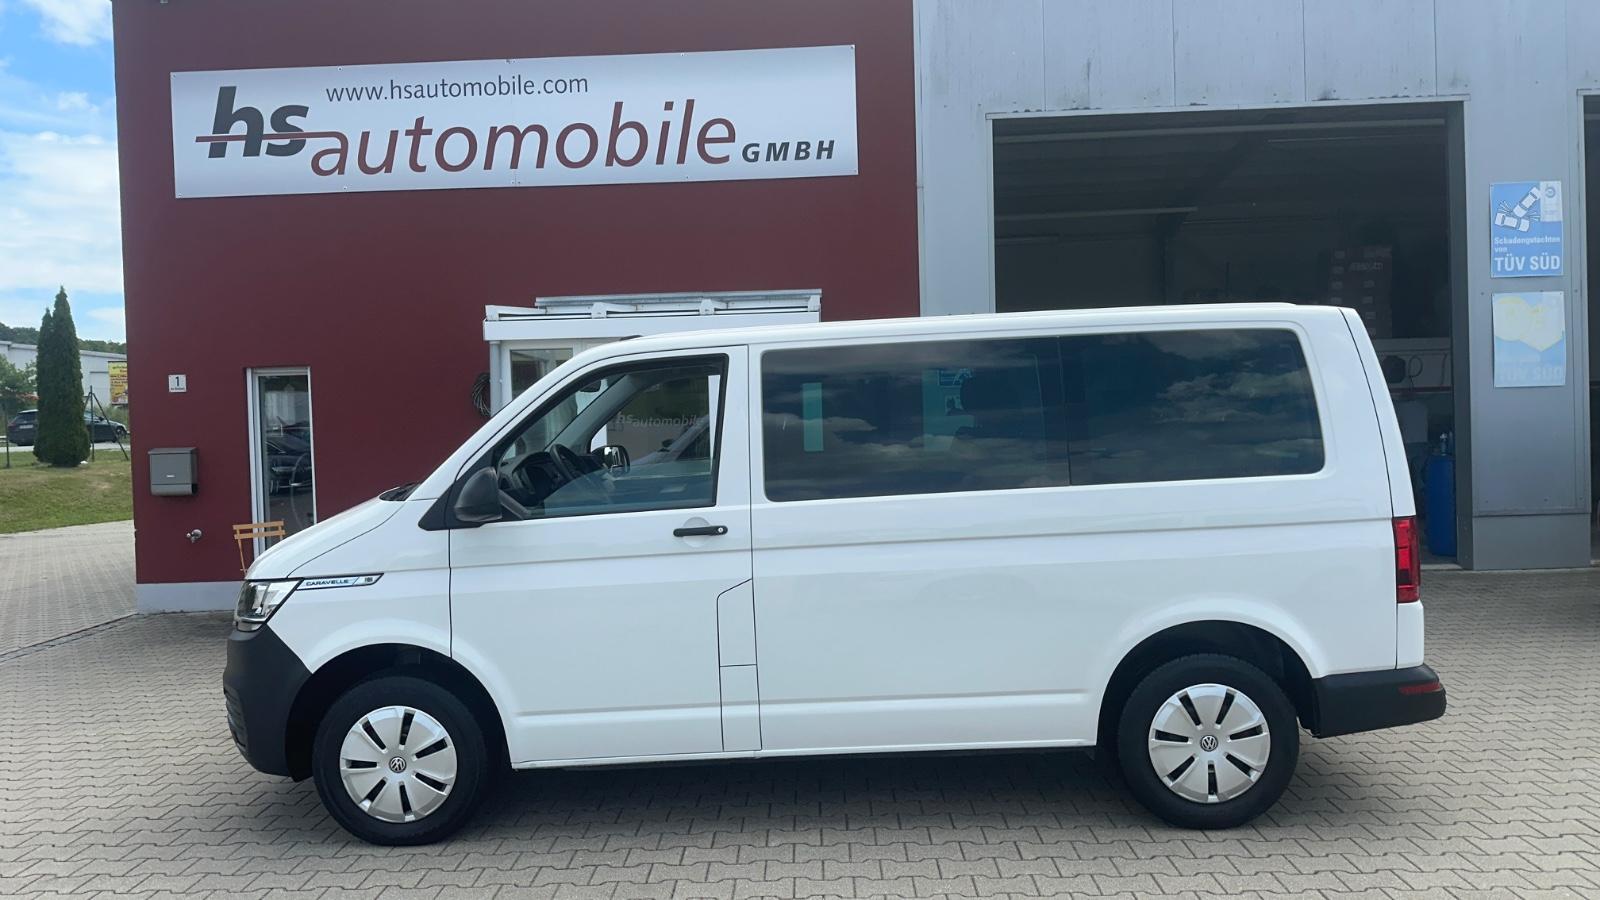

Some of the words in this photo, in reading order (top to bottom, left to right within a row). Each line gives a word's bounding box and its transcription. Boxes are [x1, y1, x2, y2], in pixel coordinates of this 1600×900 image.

[326, 74, 589, 102] www.hsautomobile.com
[207, 85, 310, 159] hs
[310, 98, 737, 177] automobile
[741, 139, 835, 163] GMBH
[1494, 253, 1526, 272] TÜV
[1529, 252, 1561, 271] SÜD
[175, 376, 179, 386] 1
